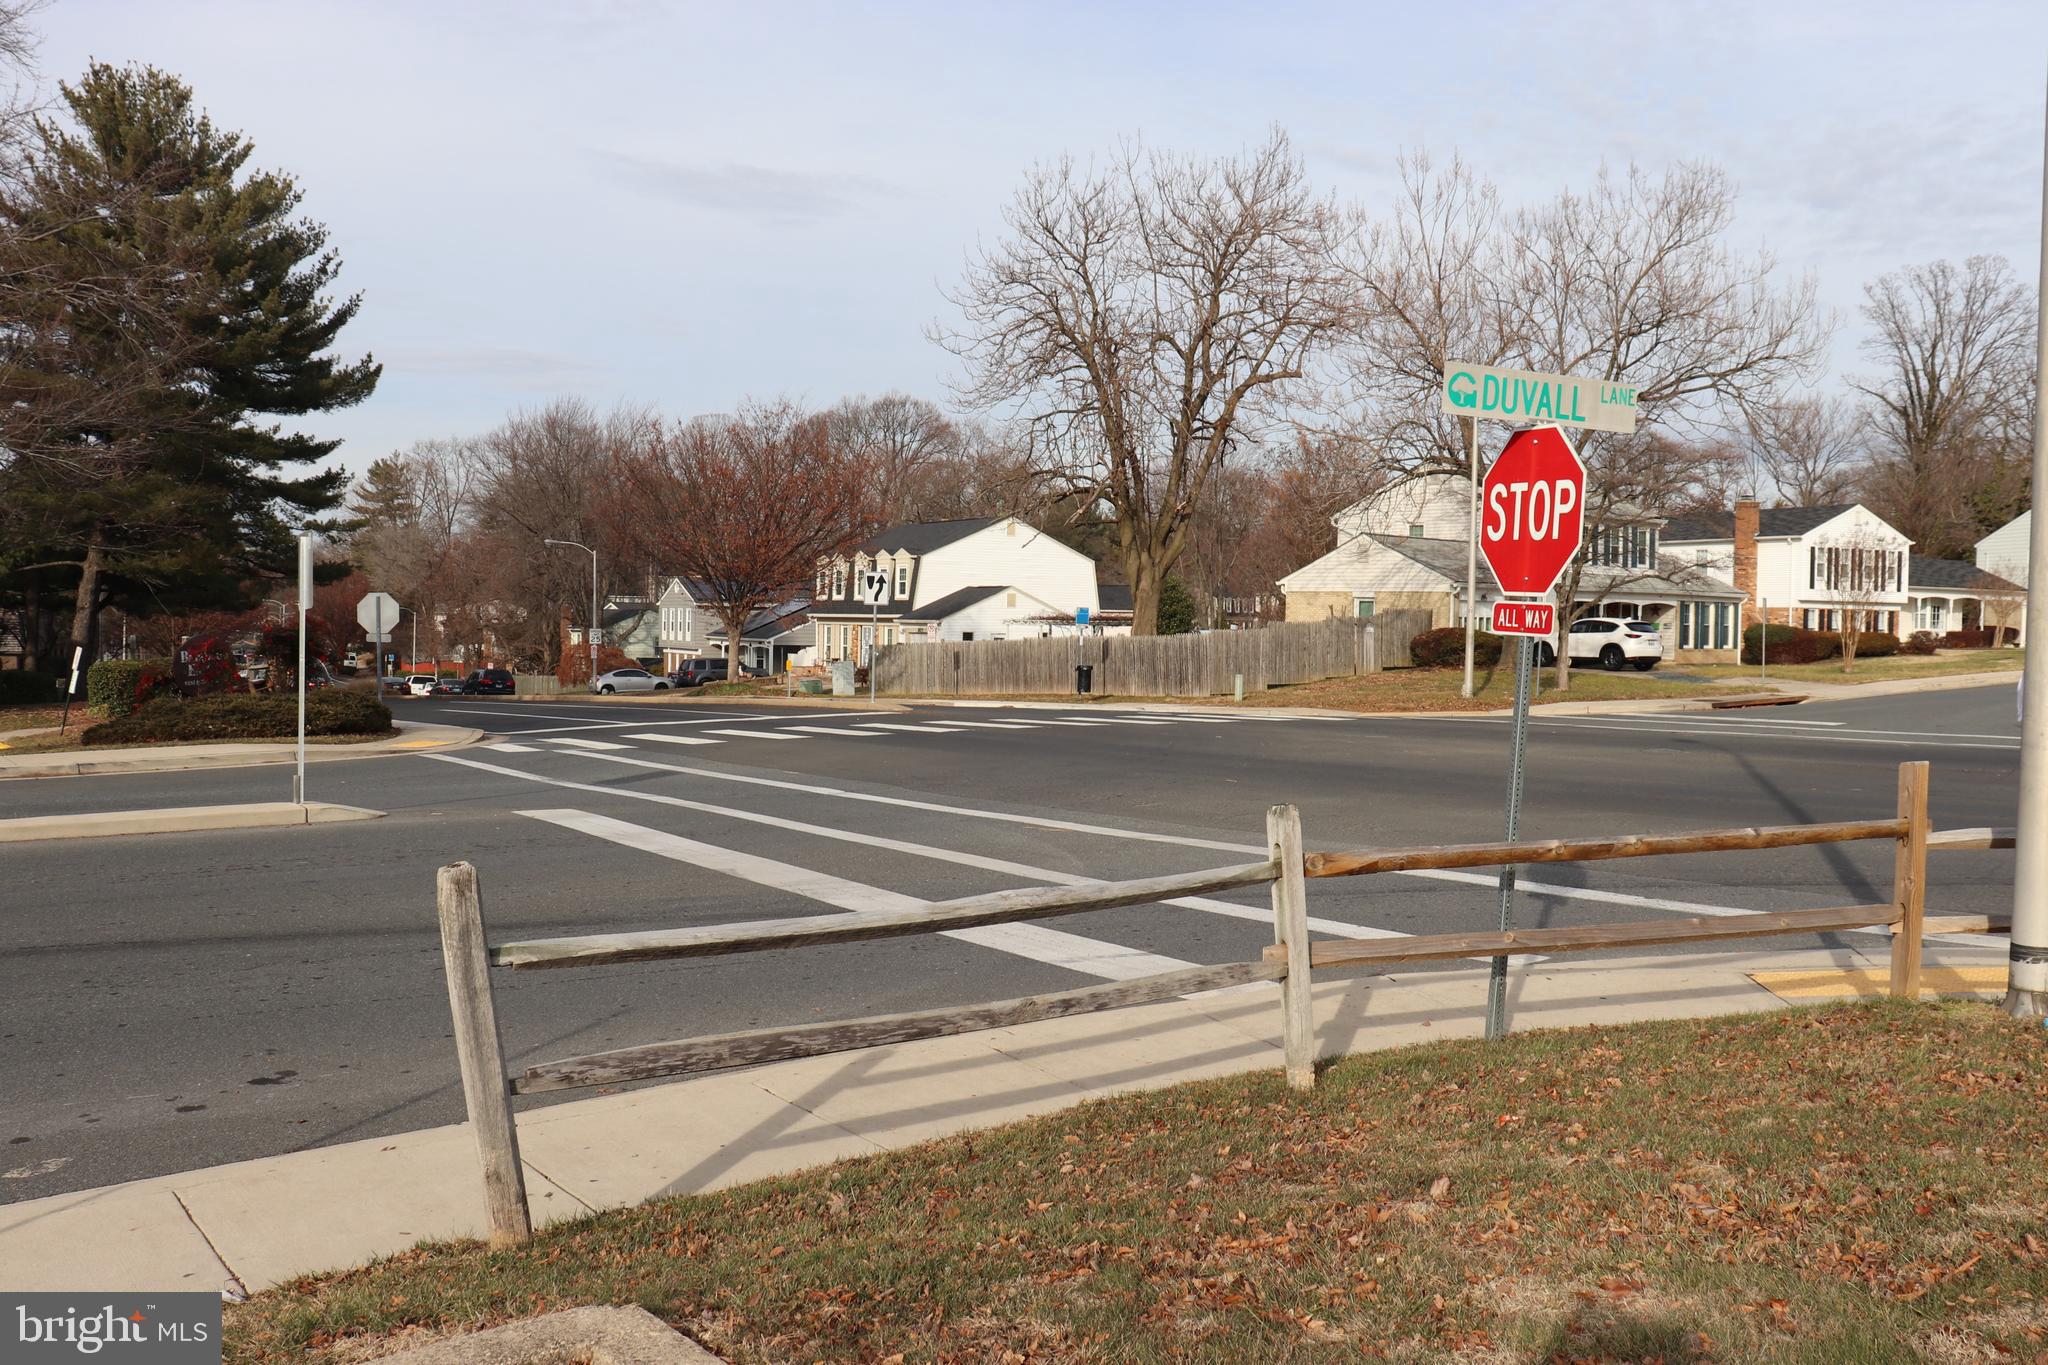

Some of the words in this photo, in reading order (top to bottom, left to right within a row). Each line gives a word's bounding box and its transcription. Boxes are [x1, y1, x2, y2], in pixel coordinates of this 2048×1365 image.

[1481, 374, 1586, 422] DUVALL
[1600, 385, 1637, 407] LANE
[1487, 479, 1576, 541] STOP
[1497, 608, 1519, 627] ALL
[1525, 609, 1549, 629] WAY
[590, 635, 601, 643] 25
